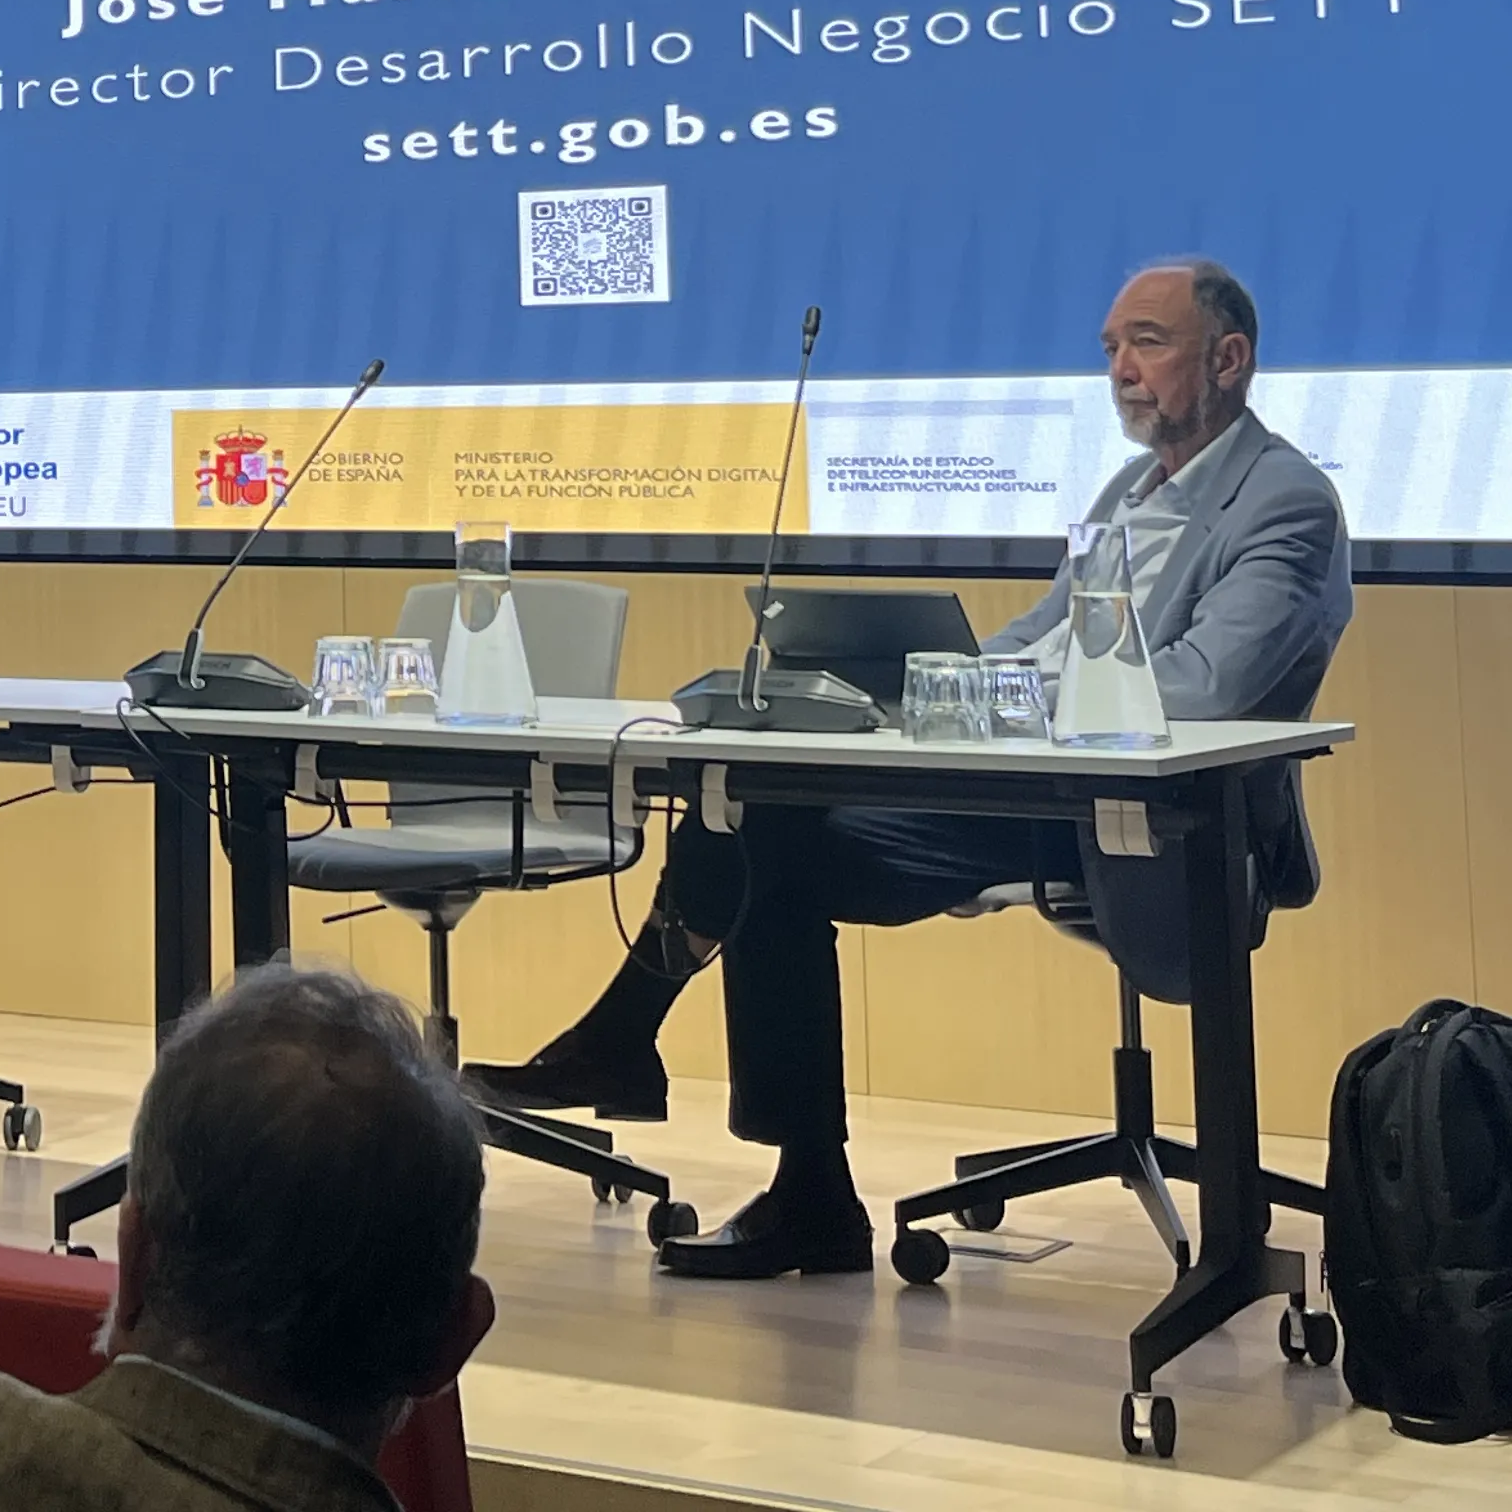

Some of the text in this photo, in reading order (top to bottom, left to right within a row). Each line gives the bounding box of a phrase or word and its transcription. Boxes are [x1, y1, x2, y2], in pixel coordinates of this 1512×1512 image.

[275, 20, 694, 92] Desarrollo
[363, 103, 840, 165] sett.gob.es
[454, 451, 554, 465] MINISTERIO
[912, 457, 932, 467] DE
[935, 457, 994, 467] ESTADO
[308, 464, 404, 482] DE ESPAÑA
[454, 465, 782, 482] PARA LA TRANSFORMACIÓN DIGITAL
[455, 482, 695, 498] Y DE LA FUNCIÓN PÚBLICA
